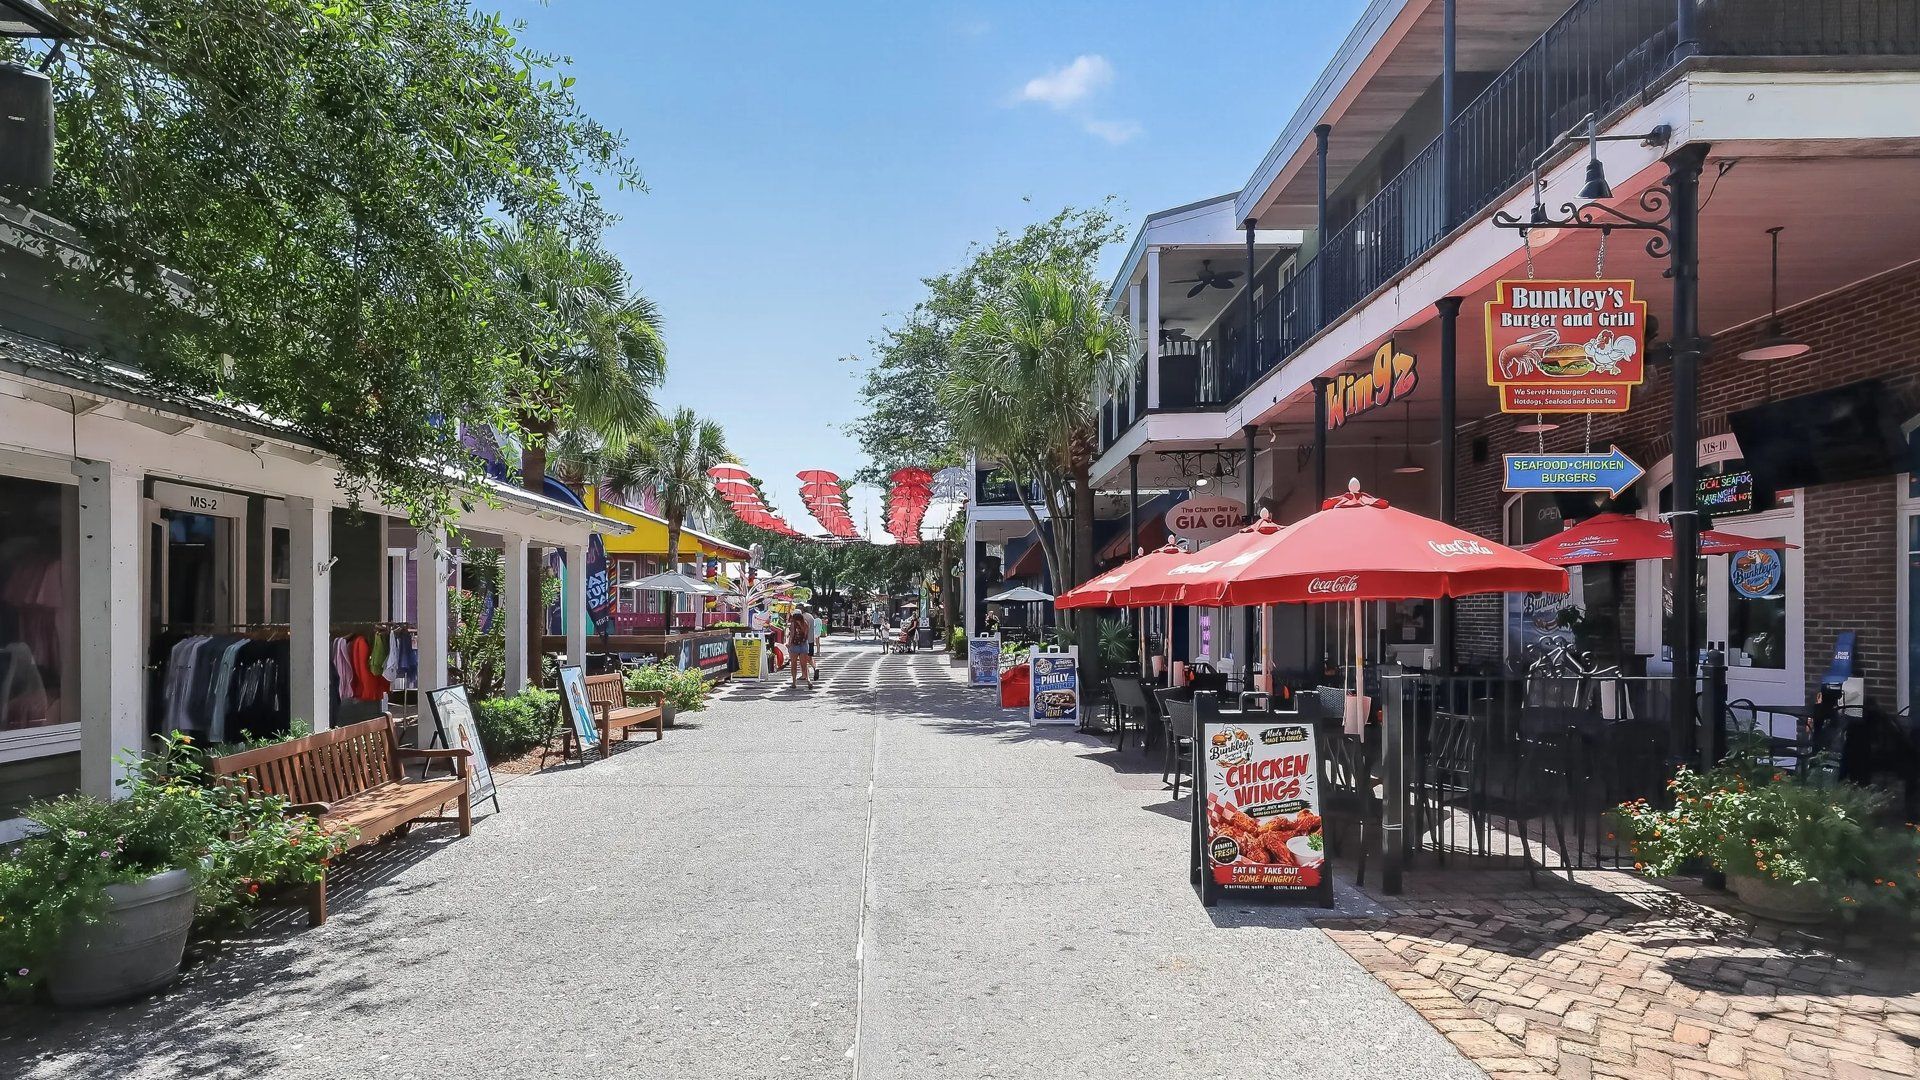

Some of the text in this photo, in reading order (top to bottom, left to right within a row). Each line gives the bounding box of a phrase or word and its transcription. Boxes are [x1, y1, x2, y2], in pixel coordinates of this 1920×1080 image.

[1512, 287, 1624, 311] Bunkley's
[1501, 311, 1636, 329] Burger and Grill
[1513, 388, 1525, 396] We
[1526, 388, 1546, 396] Serve
[1546, 388, 1588, 397] Hamburgers,
[1545, 397, 1572, 405] Seafood
[1572, 397, 1585, 405] and
[1604, 397, 1616, 405] Tea
[1702, 440, 1728, 455] MS-10
[1541, 473, 1597, 483] BURGERS
[1697, 480, 1720, 491] OCAL
[190, 495, 217, 510] MS-2
[1538, 506, 1561, 520] OPEN
[1175, 513, 1244, 530] GIA GIA
[1427, 539, 1494, 557] Coca-Cola
[1307, 575, 1360, 594] Coca-Cola
[1041, 672, 1069, 685] PHILLY
[1226, 753, 1310, 787] CHICKEN
[1234, 778, 1302, 807] WINGS
[1213, 847, 1237, 859] FRESH!
[1232, 866, 1299, 875] EAT IN TAKE OUT
[1238, 875, 1296, 884] COME HUNGRY!
